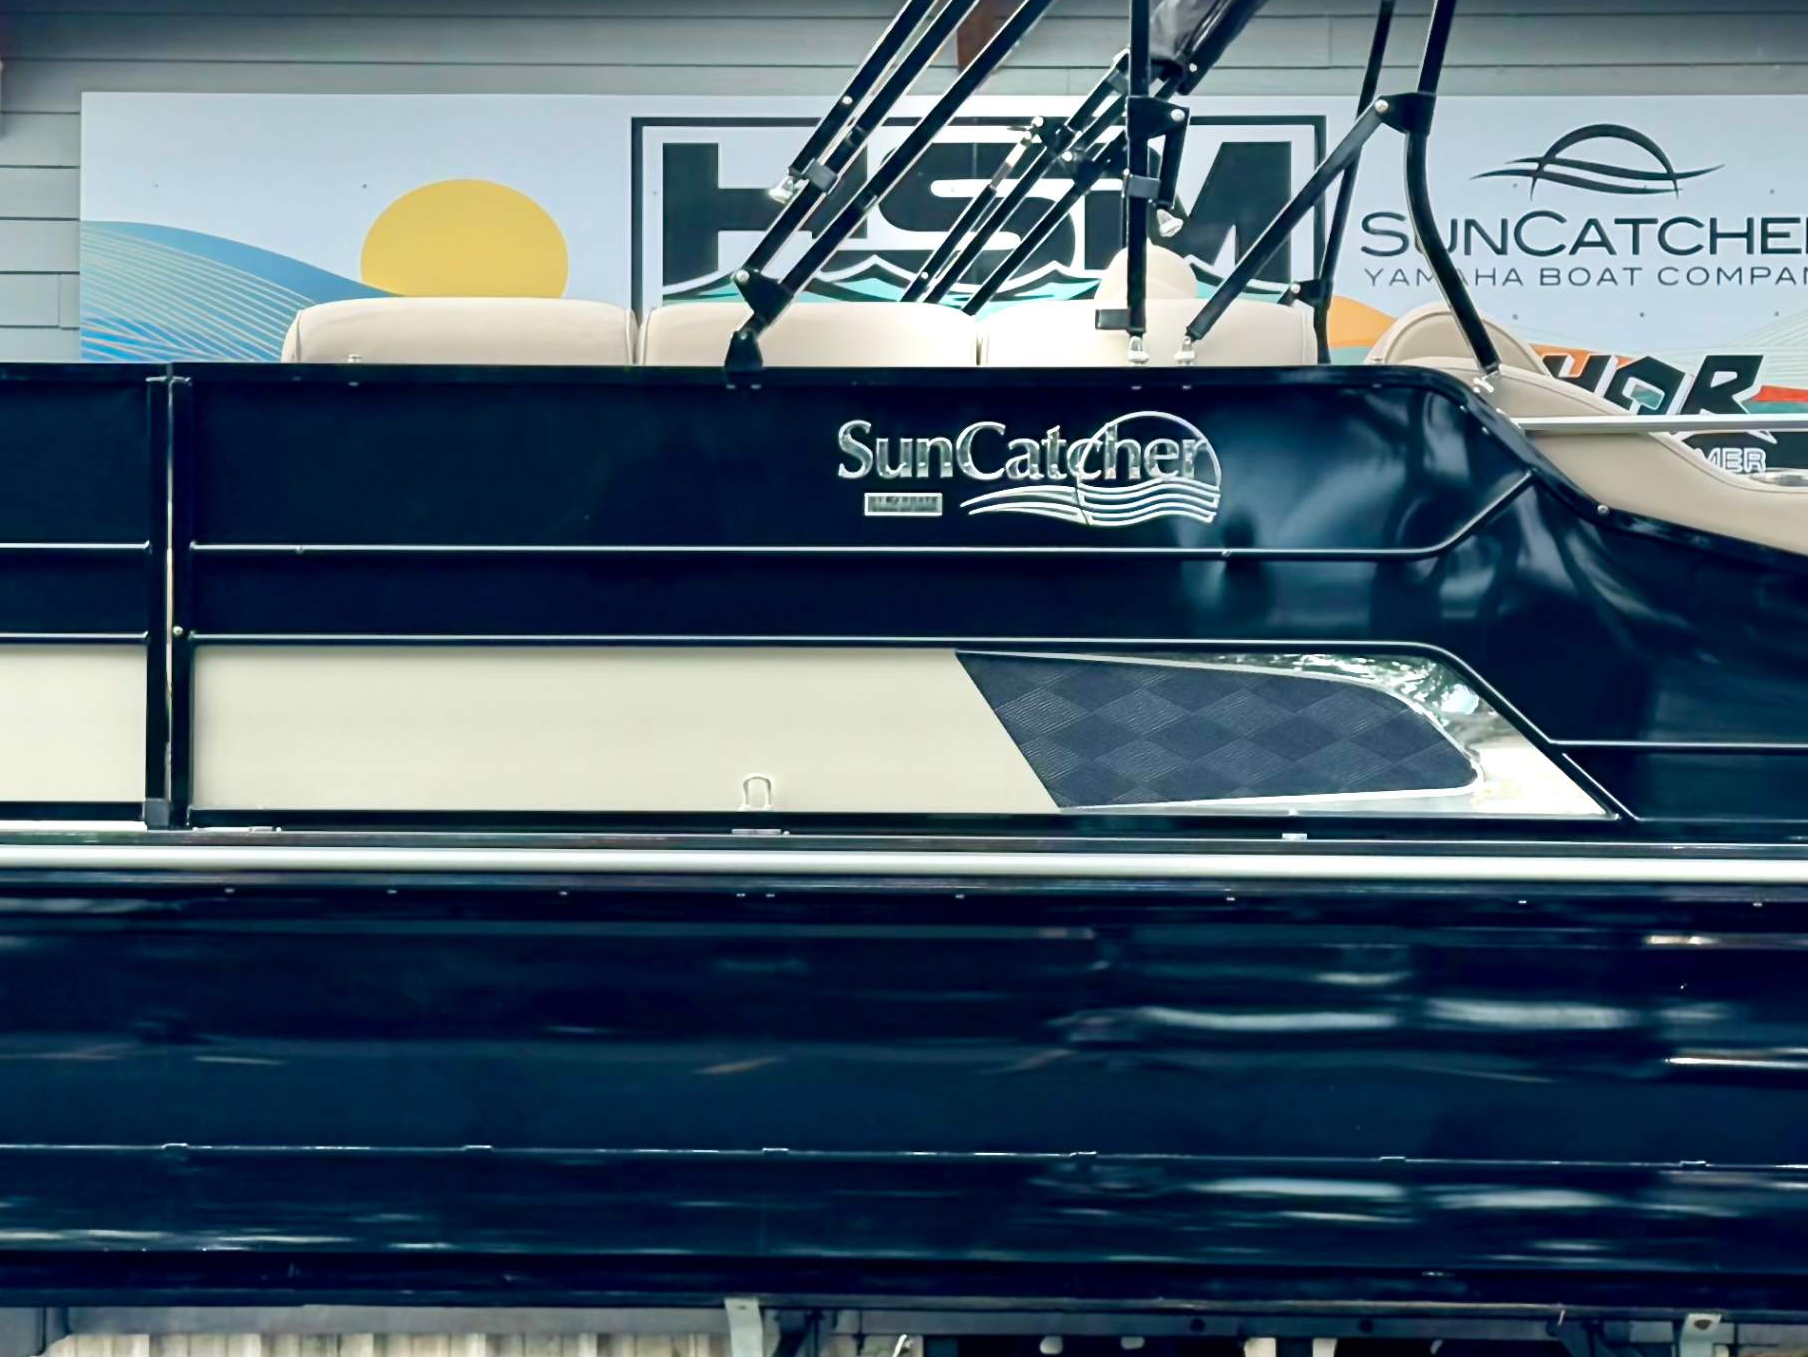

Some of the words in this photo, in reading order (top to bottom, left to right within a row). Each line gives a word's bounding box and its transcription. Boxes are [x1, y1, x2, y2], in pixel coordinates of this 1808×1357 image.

[662, 141, 1292, 290] HSM
[1364, 267, 1524, 287] YAMHA
[1539, 266, 1643, 287] BOAT
[837, 419, 1210, 481] SunCatcher
